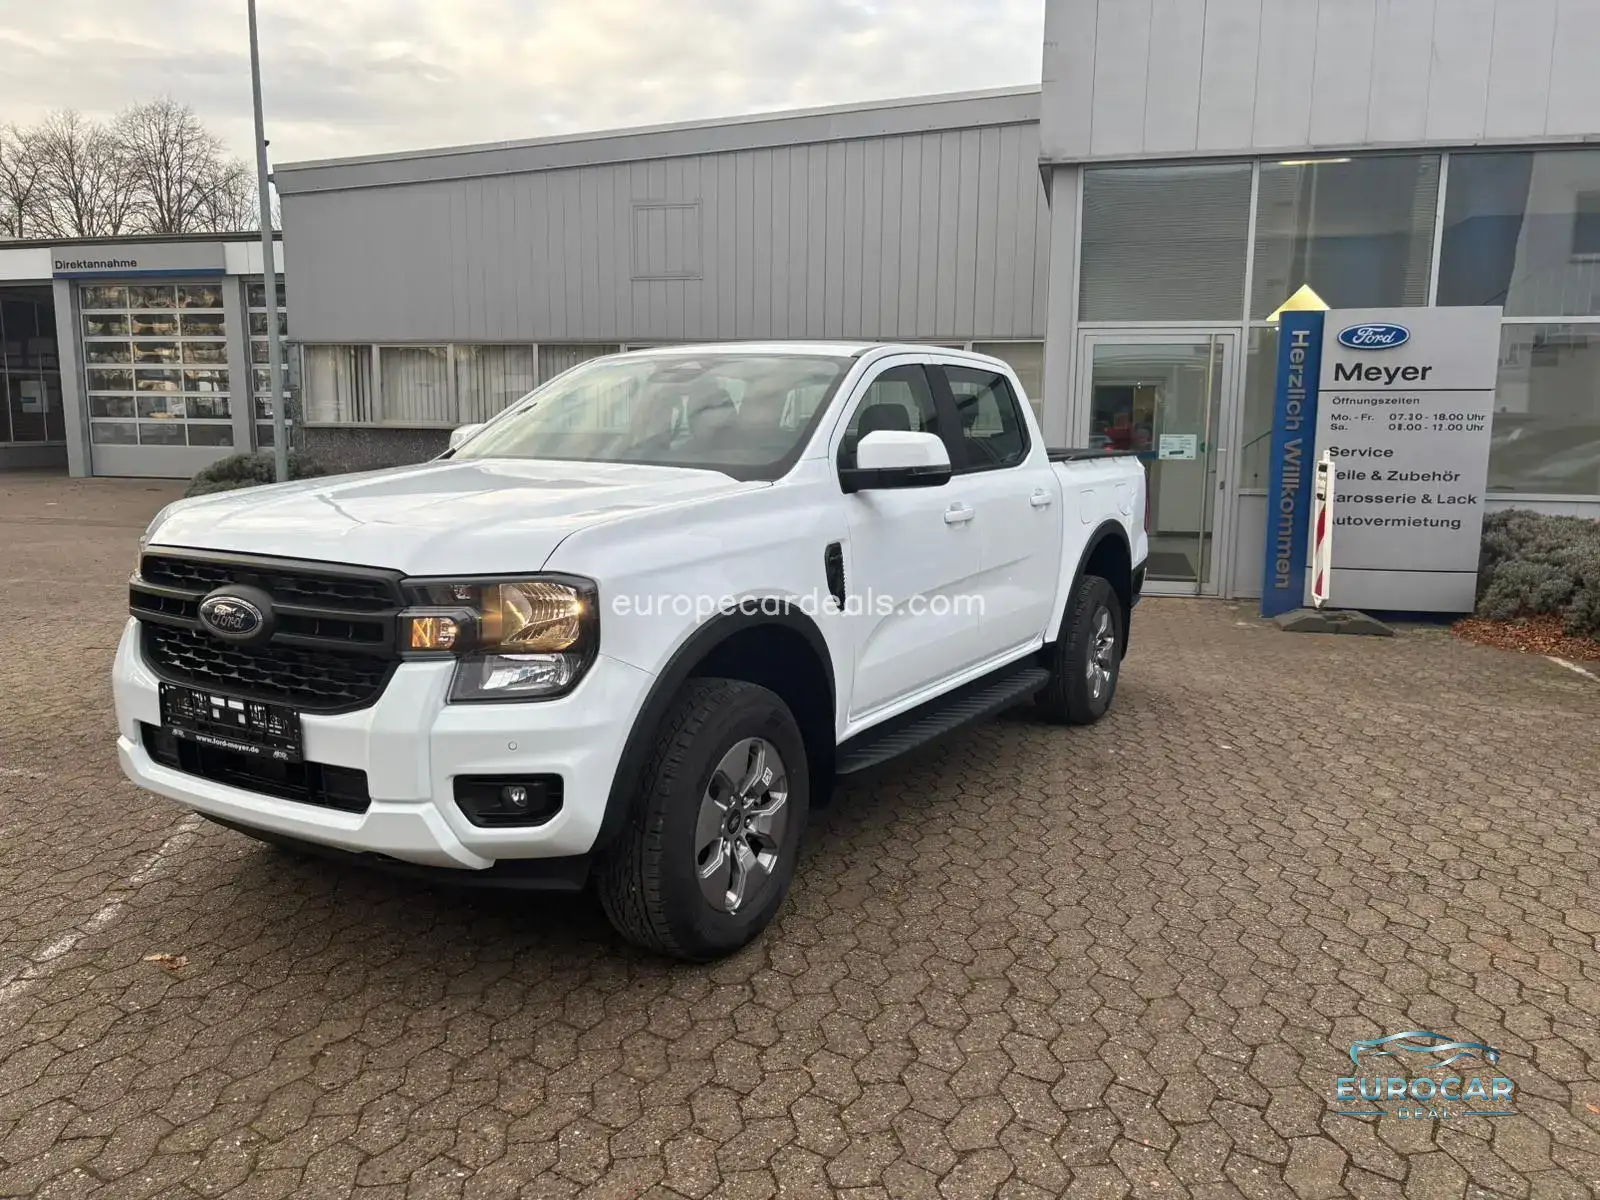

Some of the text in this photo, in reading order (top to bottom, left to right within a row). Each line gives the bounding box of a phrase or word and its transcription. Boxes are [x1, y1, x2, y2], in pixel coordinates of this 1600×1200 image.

[55, 259, 137, 270] Direktannahme
[1352, 327, 1396, 344] Ford
[1334, 362, 1432, 385] Meyer
[1284, 330, 1310, 431] Herzlich
[1332, 396, 1420, 406] Öffnungszeiten
[1330, 413, 1351, 421] Mo.
[1360, 413, 1375, 421] Fr.
[1433, 413, 1464, 421] 18.00
[1466, 413, 1486, 421] Uhr
[1330, 423, 1348, 431] Sa.
[1465, 423, 1485, 431] Uhr
[1328, 446, 1394, 458] Service
[1335, 469, 1461, 482] eile & Zubehör
[1333, 492, 1477, 505] arosserie & Lack
[1275, 438, 1303, 588] Willkommen
[1333, 515, 1461, 530] utovermietung
[211, 604, 245, 628] Ford
